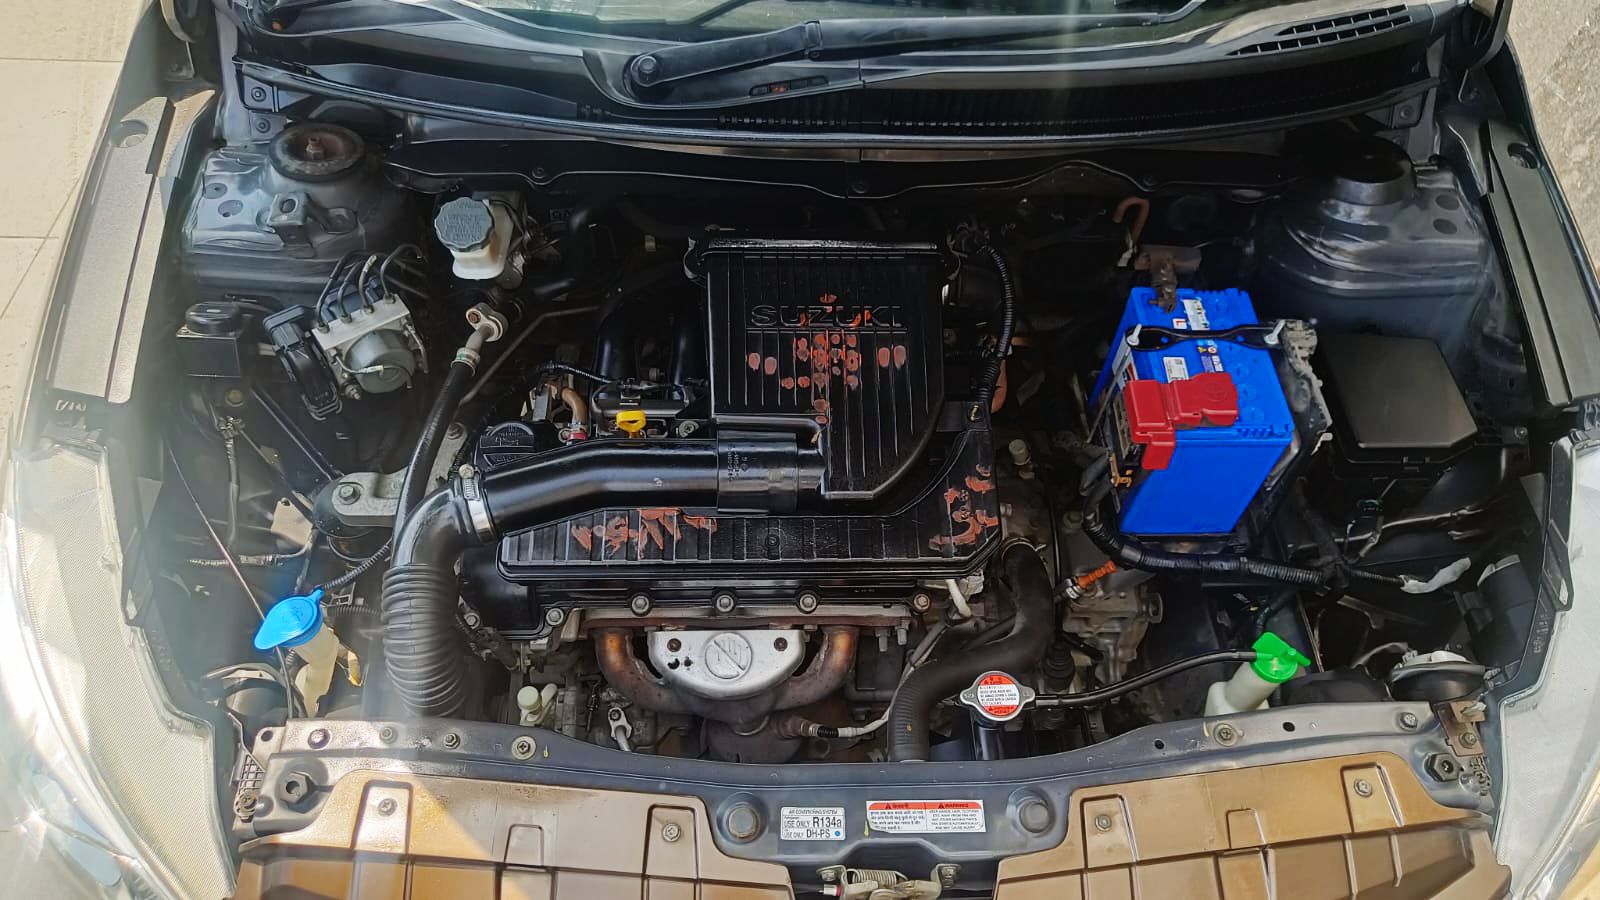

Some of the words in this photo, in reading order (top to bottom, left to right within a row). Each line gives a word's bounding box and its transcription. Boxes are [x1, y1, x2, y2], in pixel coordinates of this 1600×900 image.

[751, 304, 902, 327] SUZUKI
[812, 816, 842, 828] R134a
[806, 829, 830, 838] DH-PS
